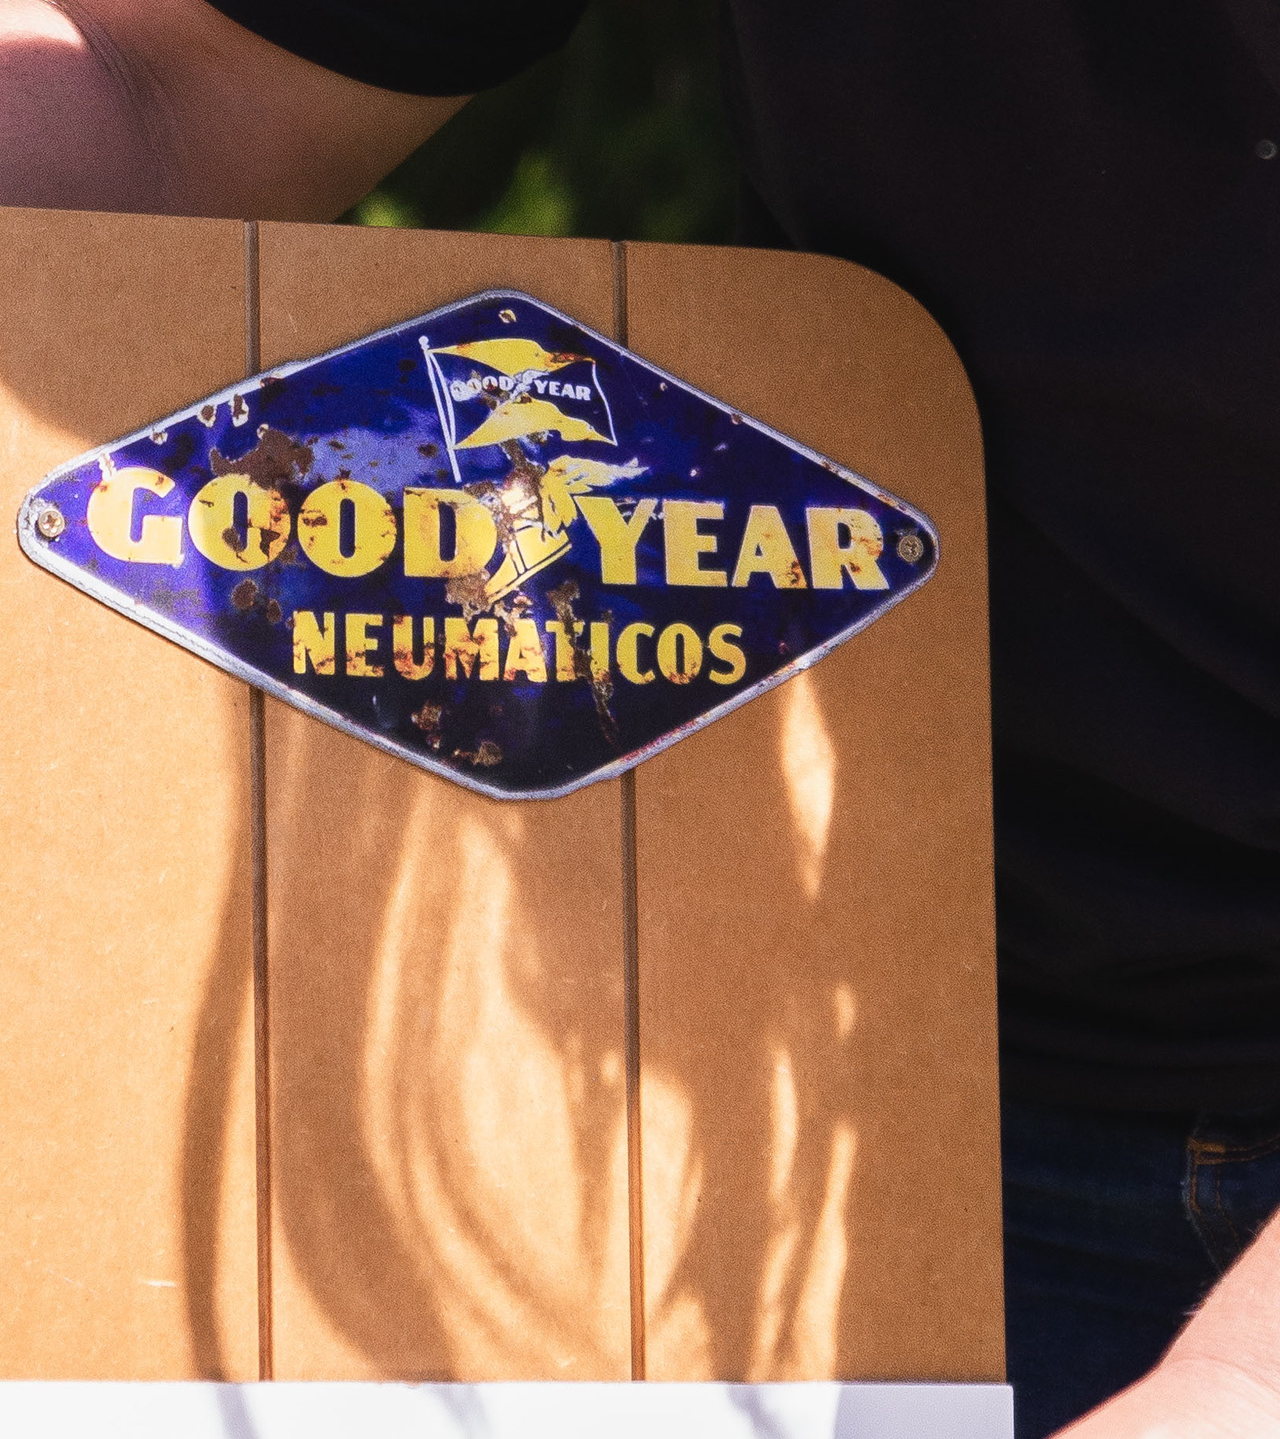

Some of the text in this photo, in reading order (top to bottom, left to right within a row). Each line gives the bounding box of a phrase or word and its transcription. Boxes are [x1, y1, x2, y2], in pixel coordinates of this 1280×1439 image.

[534, 379, 591, 401] YEAR
[86, 467, 890, 590] GOOD YEAR
[292, 610, 748, 685] NEUMATICOS
